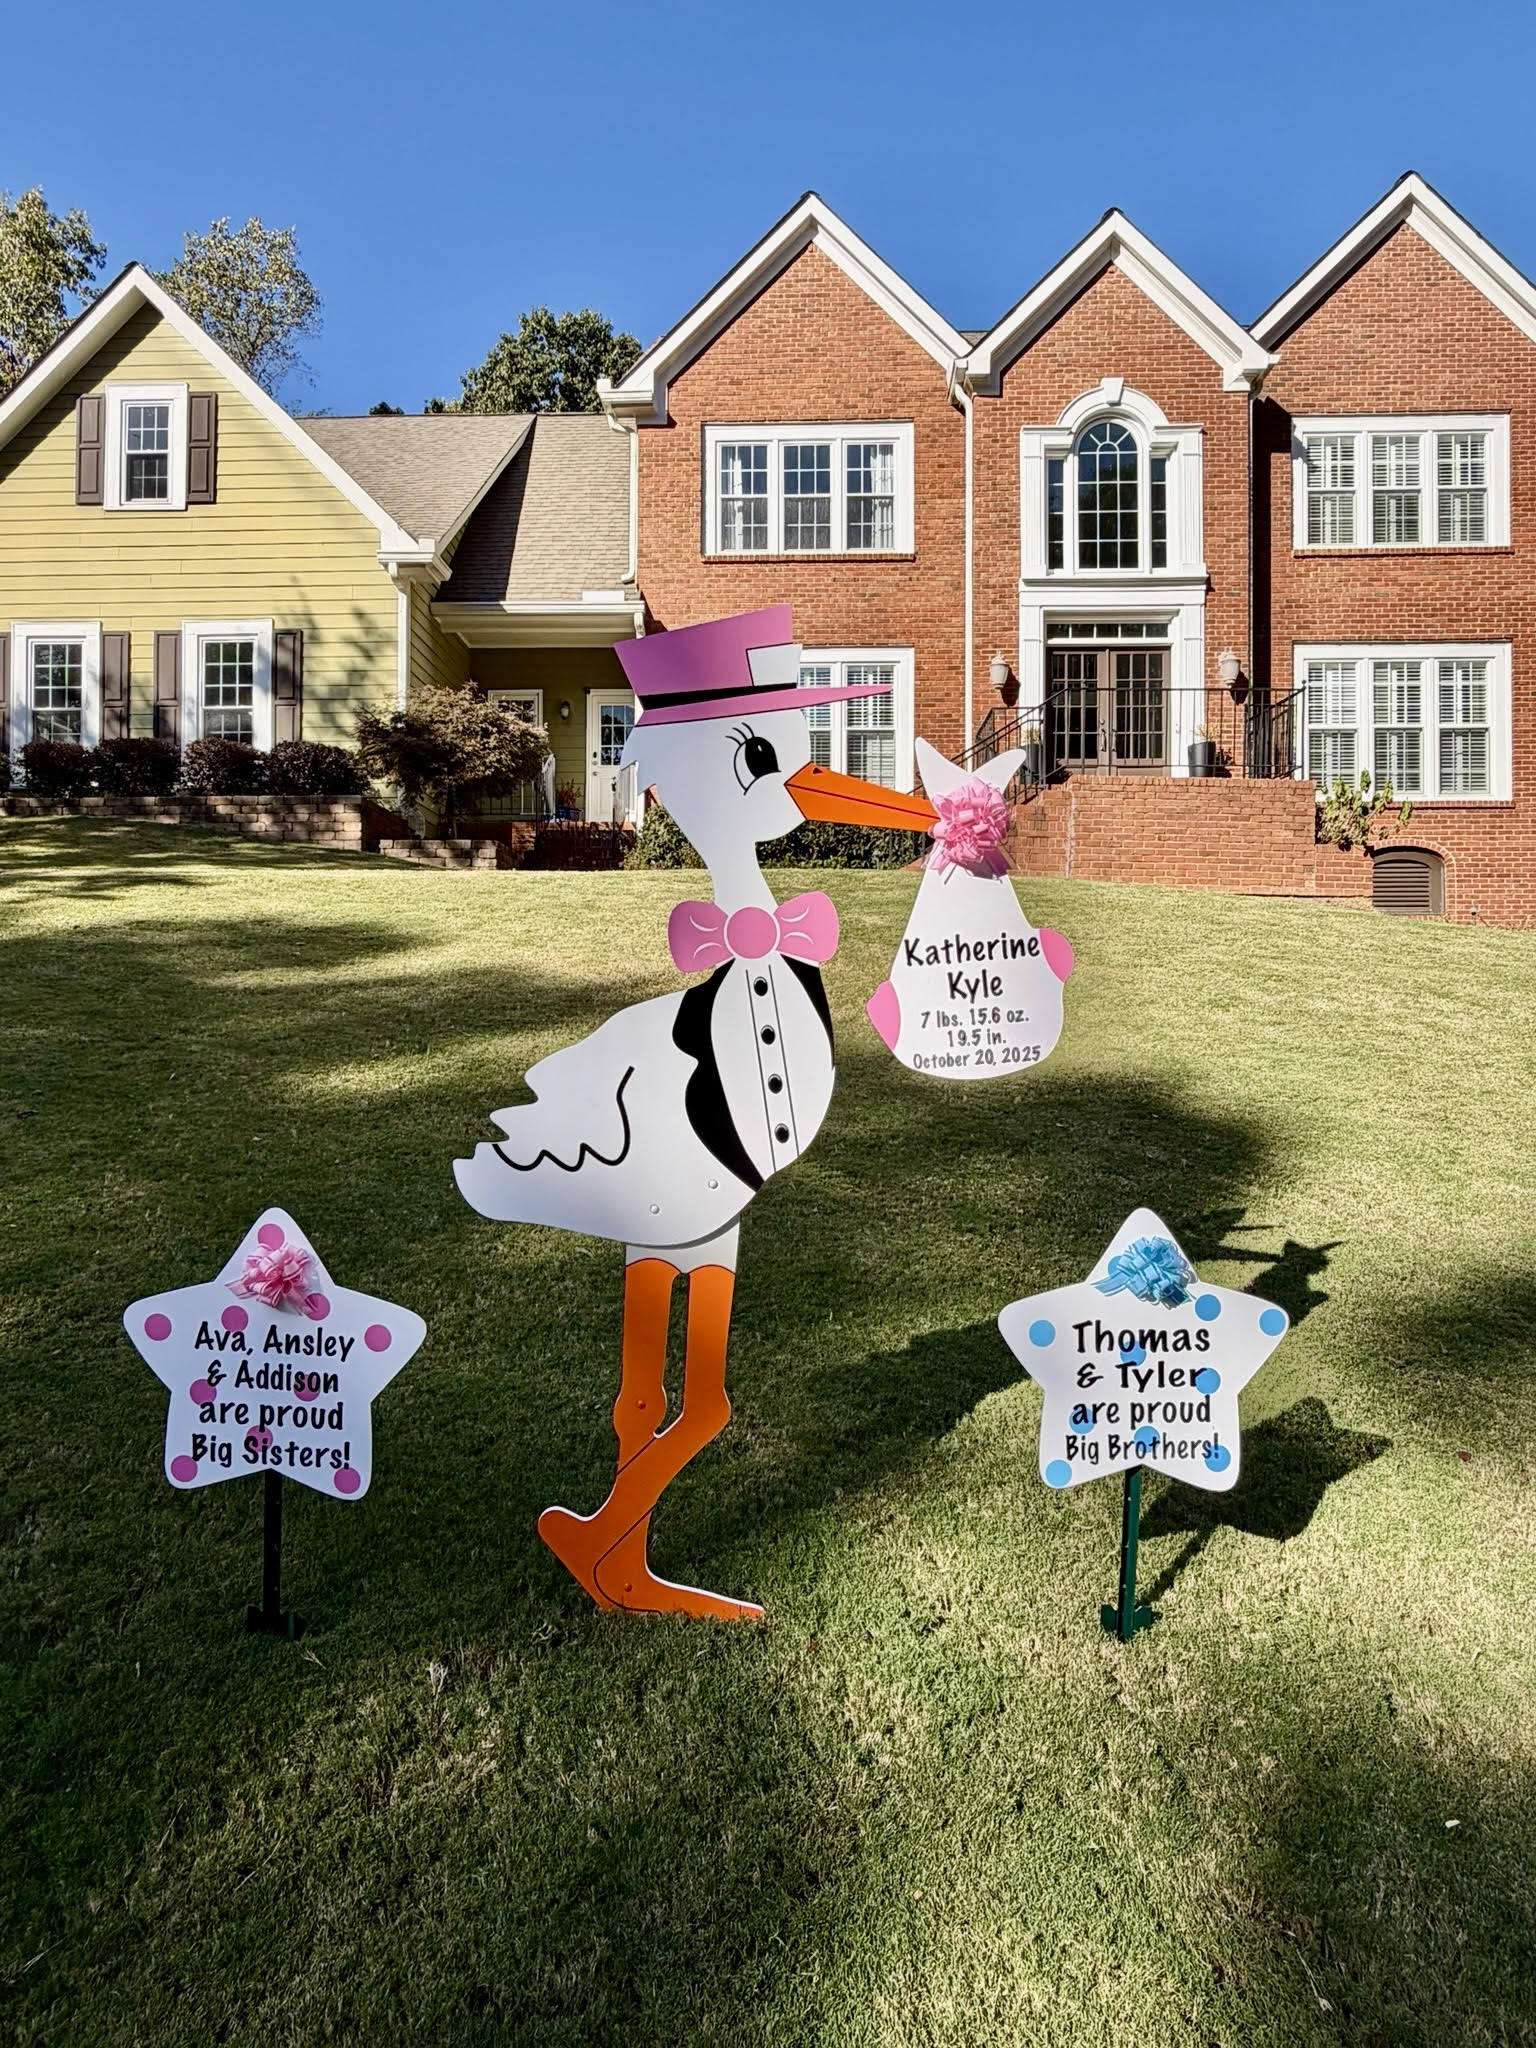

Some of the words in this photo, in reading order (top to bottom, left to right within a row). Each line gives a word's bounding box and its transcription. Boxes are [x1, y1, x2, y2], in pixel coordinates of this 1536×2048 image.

[904, 932, 1040, 967] Katherine
[947, 969, 1004, 1004] Kyle
[920, 1011, 931, 1029] 7
[936, 1010, 963, 1028] lbs.
[969, 1006, 1001, 1026] 15.6
[1006, 1009, 1030, 1024] oz.
[947, 1029, 982, 1048] 19.5
[986, 1029, 1007, 1046] in.
[913, 1051, 970, 1070] October
[974, 1049, 997, 1066] 20,
[1001, 1045, 1041, 1063] 2025
[194, 1320, 254, 1356] Ava,
[263, 1324, 355, 1363] Ansley
[1072, 1319, 1211, 1354] Thomas
[207, 1359, 227, 1388] &
[234, 1359, 339, 1394] Addison
[1076, 1362, 1104, 1389] &
[1115, 1361, 1208, 1393] Tyler
[199, 1401, 250, 1425] are
[259, 1401, 344, 1433] proud
[1071, 1401, 1121, 1425] are
[1130, 1394, 1211, 1430] proud
[192, 1433, 232, 1468] Big
[242, 1435, 351, 1470] Sisters!
[1065, 1434, 1099, 1465] Big
[1108, 1432, 1220, 1461] Brothers!
